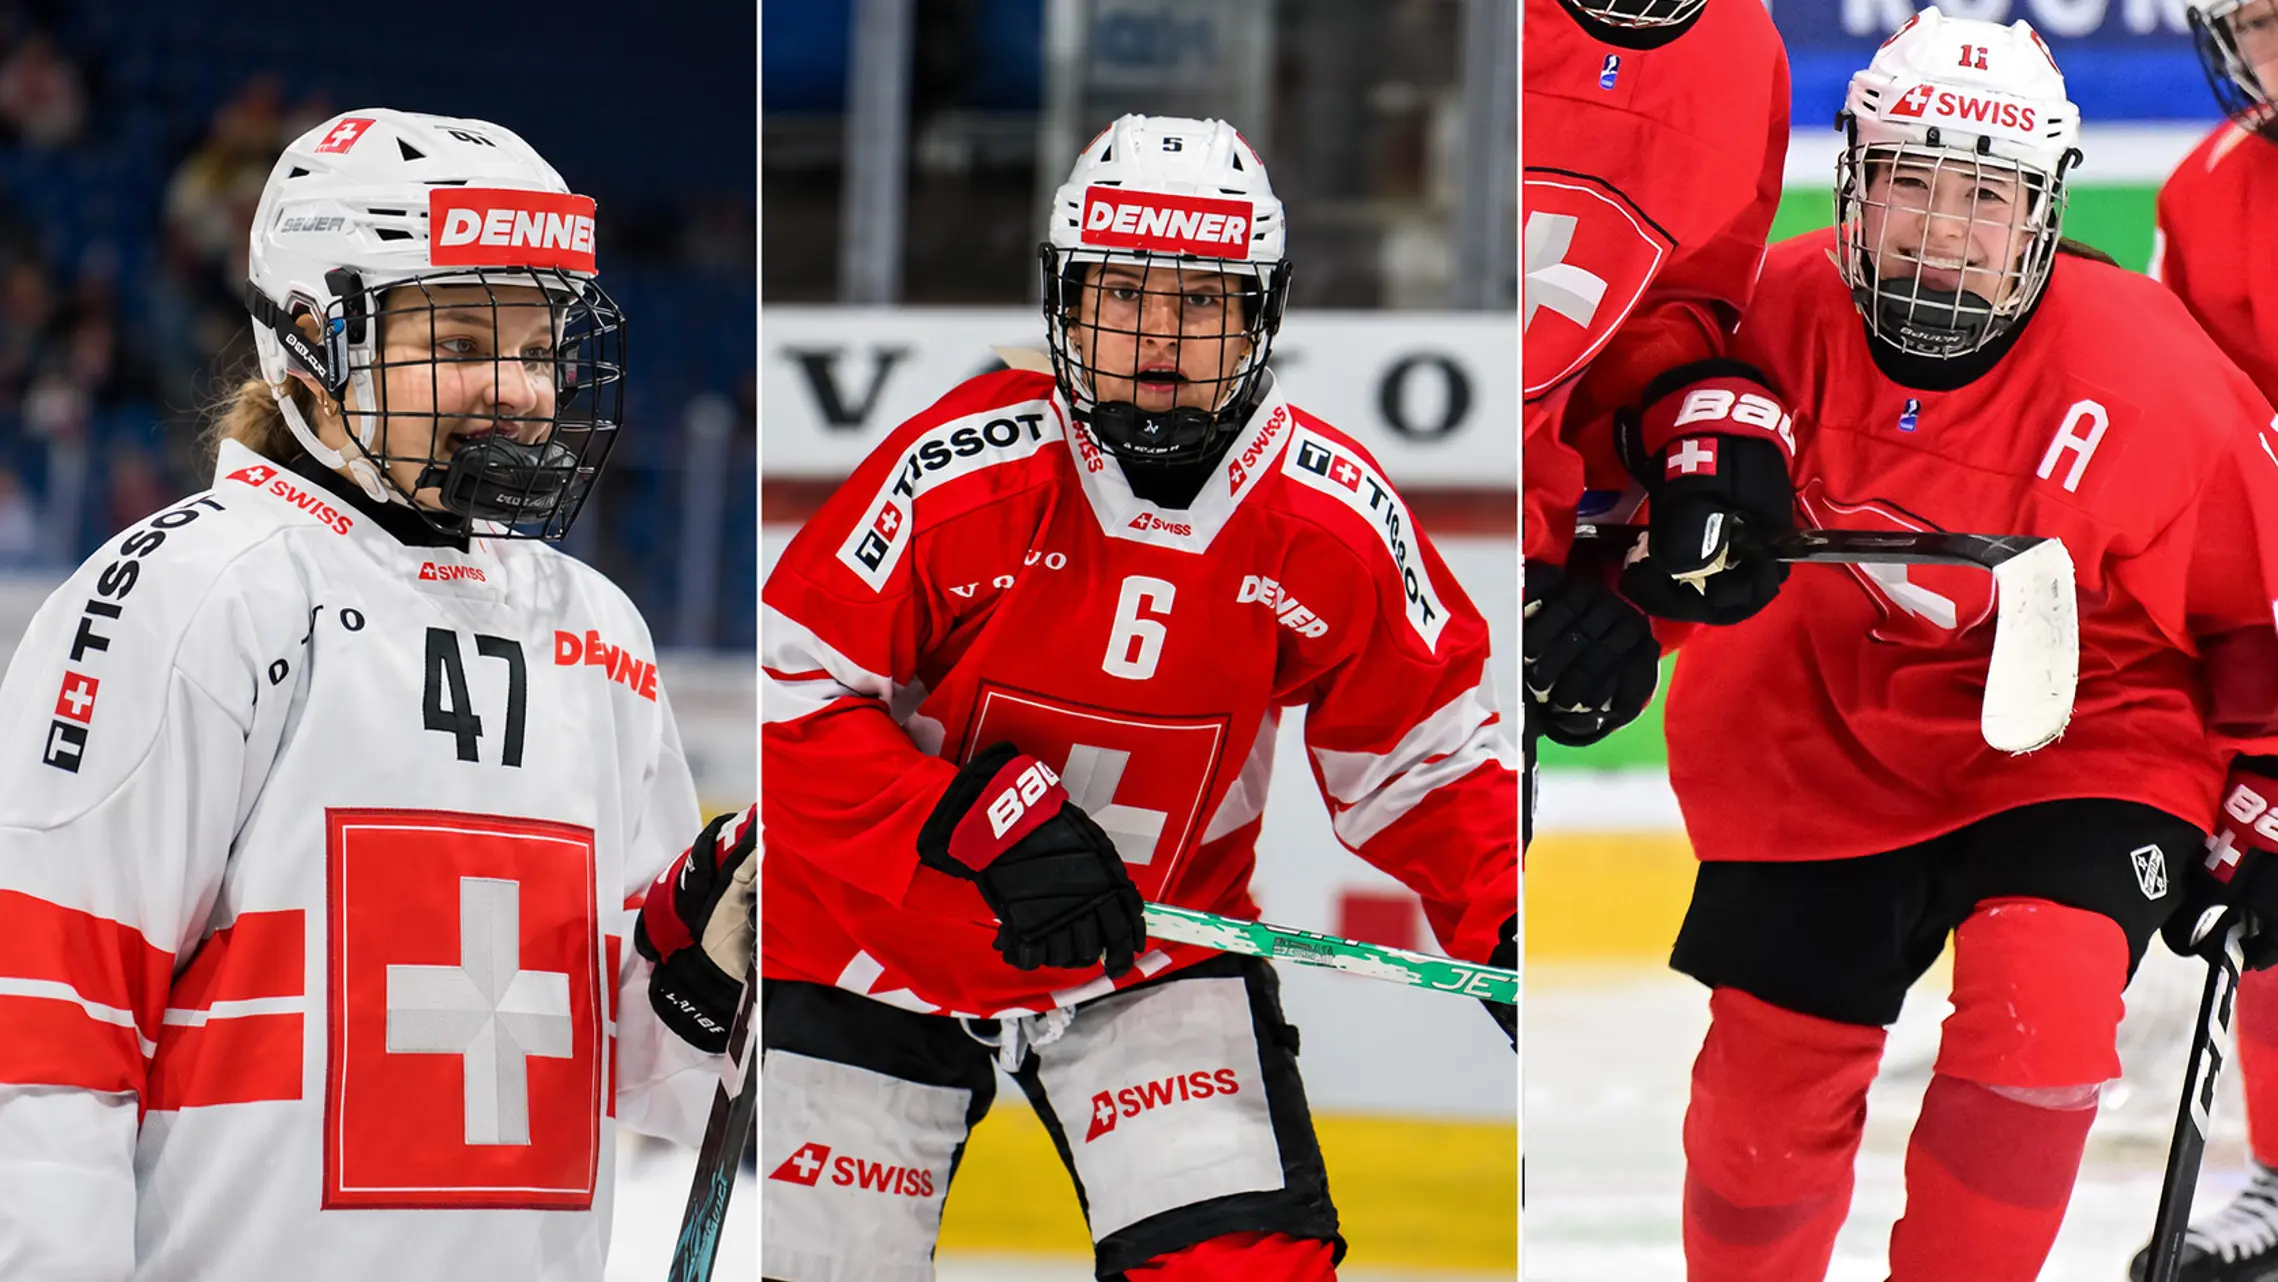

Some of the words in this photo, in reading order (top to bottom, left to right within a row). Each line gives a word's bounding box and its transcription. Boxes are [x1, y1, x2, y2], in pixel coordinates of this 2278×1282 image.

[1935, 92, 2037, 132] SWISS
[1162, 137, 1182, 152] 5
[1086, 200, 1247, 245] DENNER
[893, 413, 1043, 498] TISSOT
[2036, 399, 2109, 493] A
[269, 480, 353, 535] SWISS
[70, 494, 226, 662] TISSOT
[438, 565, 486, 582] SWISS
[1366, 476, 1436, 626] TISSOT
[1102, 575, 1176, 680] 6
[422, 627, 527, 768] 47
[554, 630, 657, 703] DENNE
[1118, 1068, 1239, 1118] SWISS
[832, 1156, 934, 1198] SWISS
